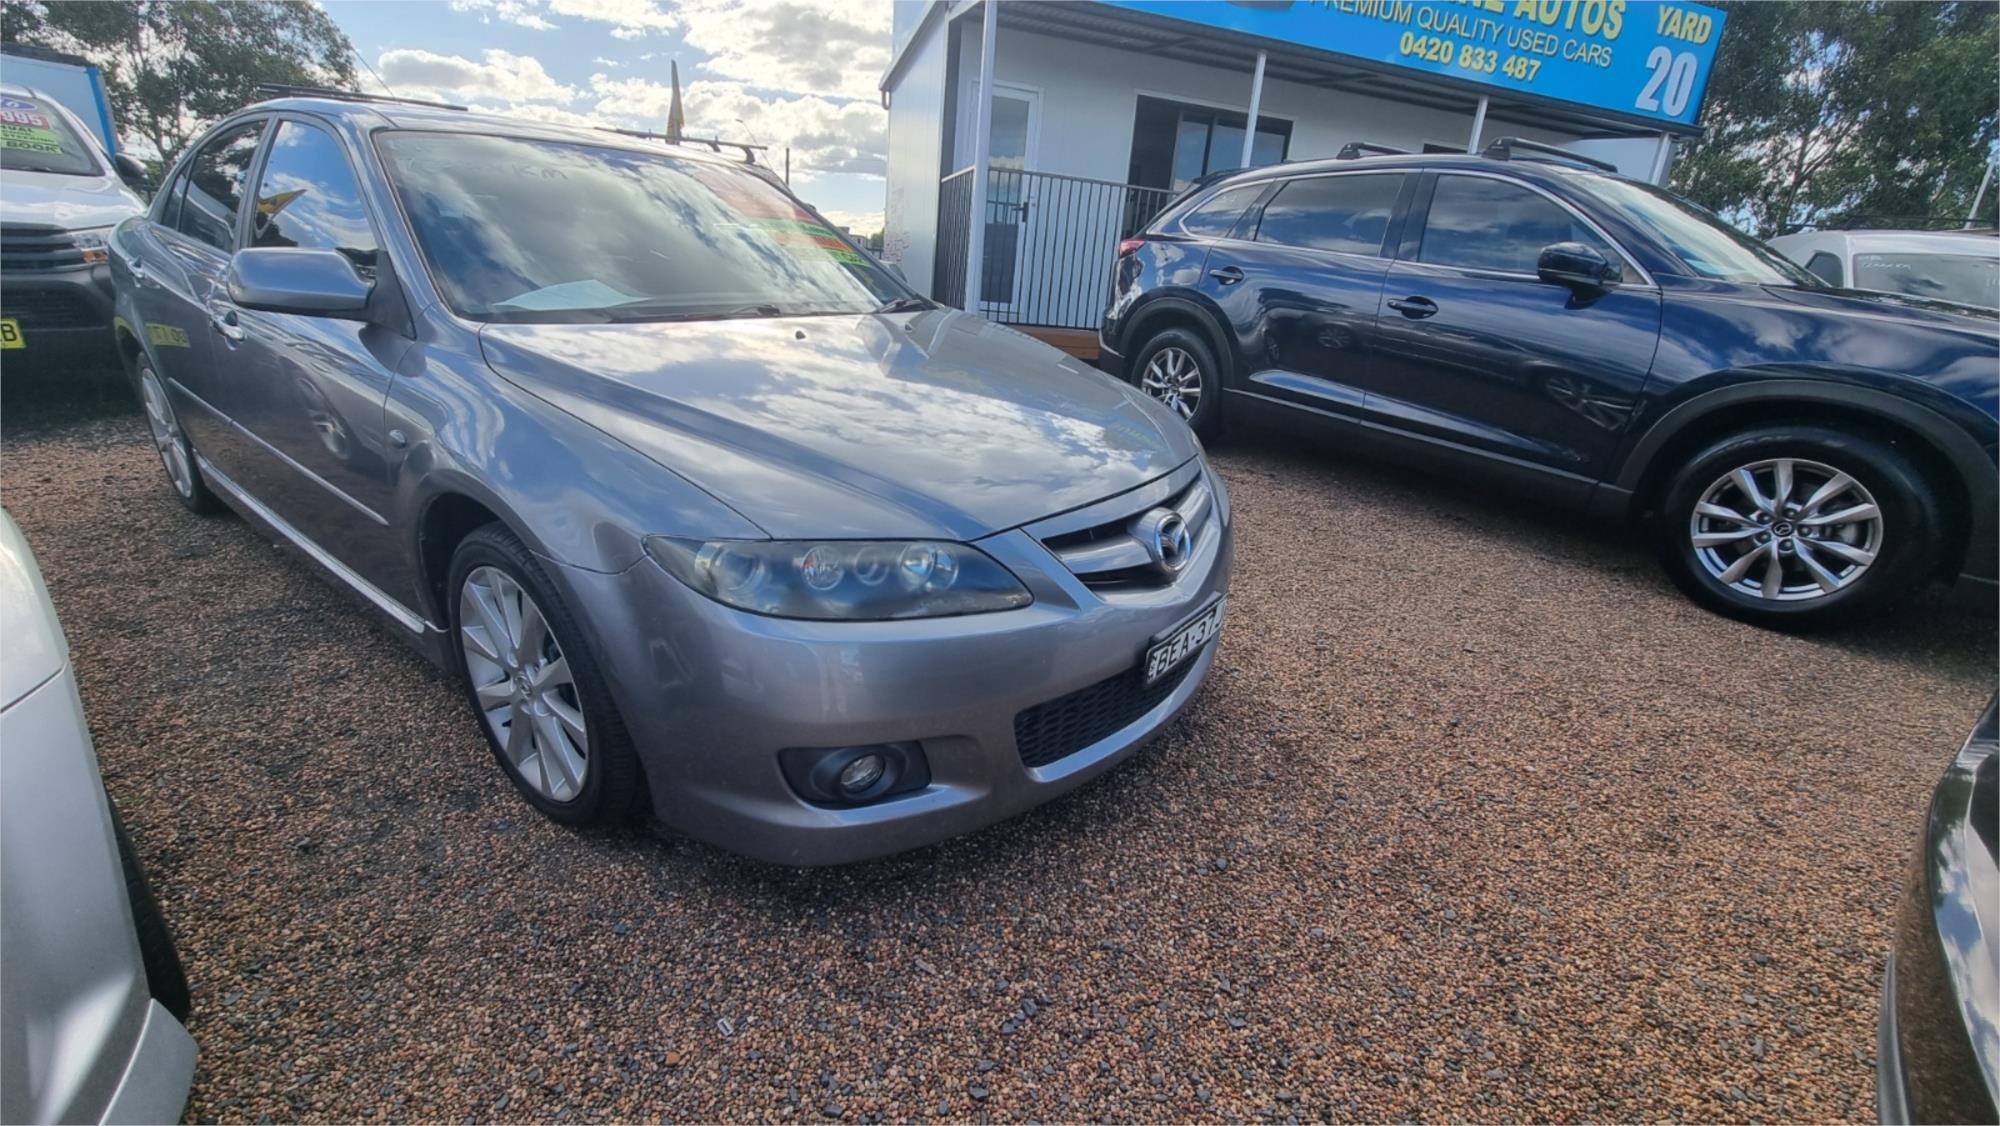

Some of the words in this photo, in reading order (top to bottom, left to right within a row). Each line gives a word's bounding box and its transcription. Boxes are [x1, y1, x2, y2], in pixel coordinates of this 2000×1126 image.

[1310, 0, 1412, 25] EMIUM
[1417, 6, 1504, 43] QUALITY
[1507, 26, 1558, 56] USED
[1563, 39, 1613, 67] CARS
[1513, 0, 1626, 40] AUTOS
[1656, 4, 1712, 44] YARD
[1400, 31, 1454, 64] 0420
[1459, 44, 1498, 73] 833
[1502, 55, 1541, 80] 487
[1635, 46, 1698, 117] 20
